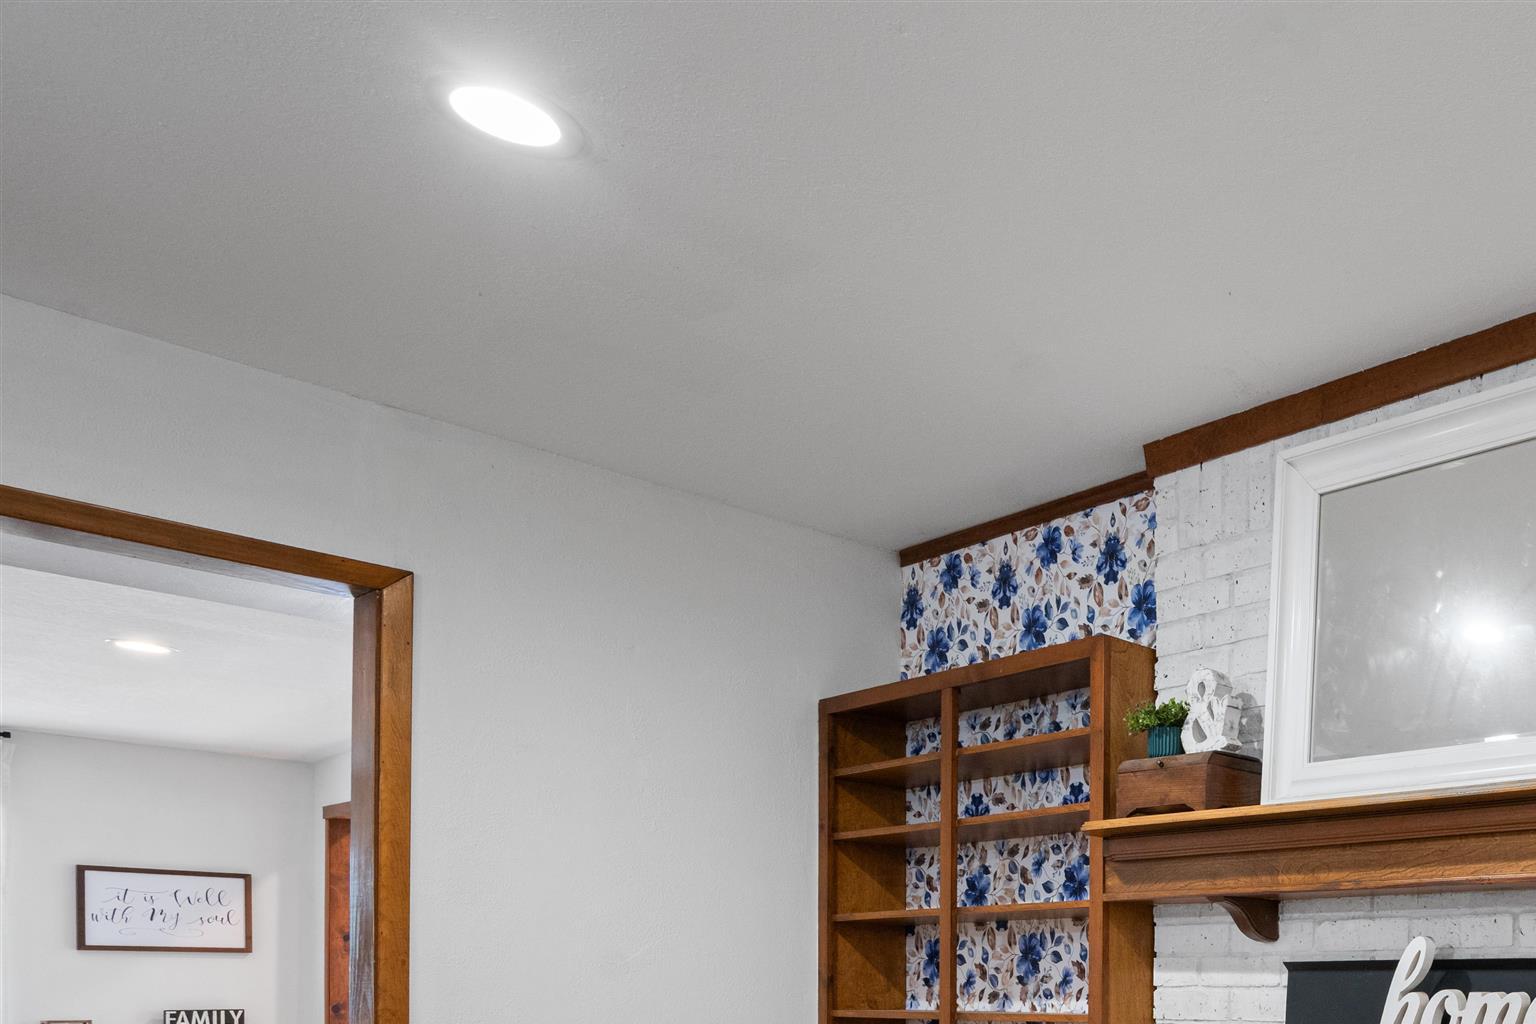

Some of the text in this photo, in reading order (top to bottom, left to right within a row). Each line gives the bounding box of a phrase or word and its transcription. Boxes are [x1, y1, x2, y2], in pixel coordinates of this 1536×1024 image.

[143, 893, 156, 904] is
[90, 906, 134, 924] with
[196, 909, 241, 926] soul
